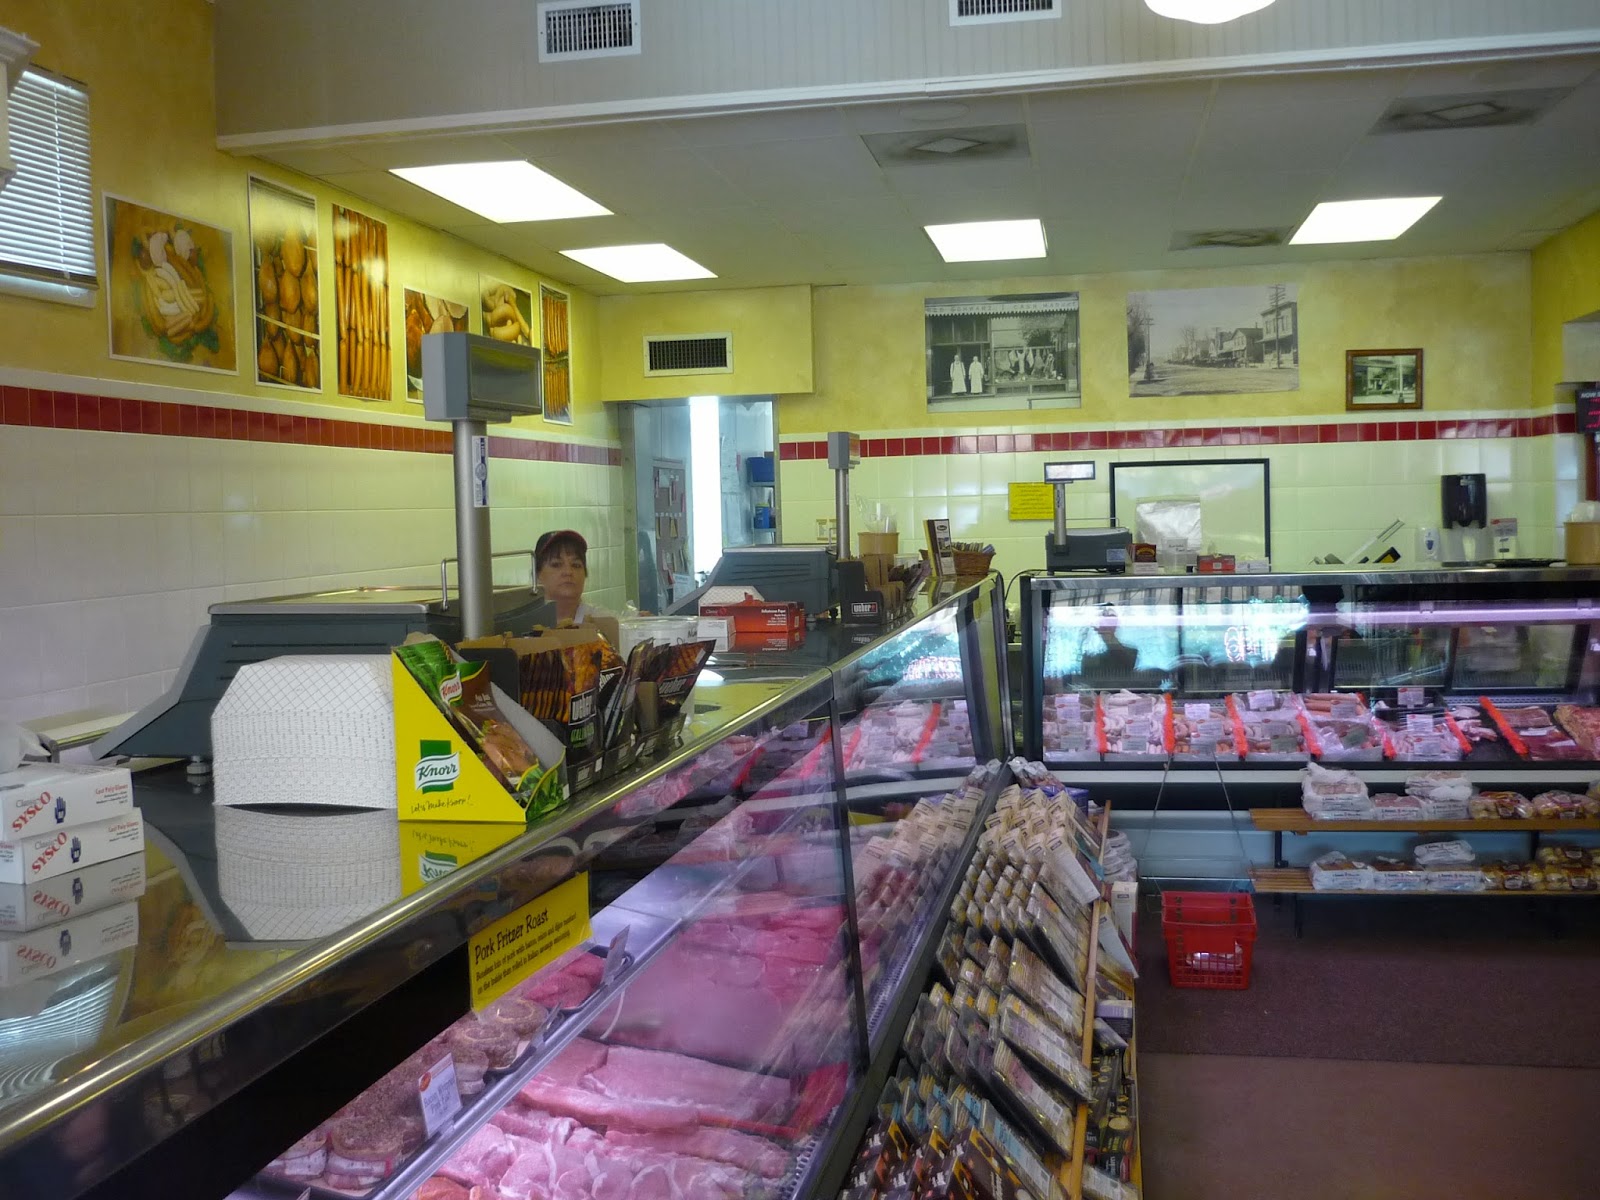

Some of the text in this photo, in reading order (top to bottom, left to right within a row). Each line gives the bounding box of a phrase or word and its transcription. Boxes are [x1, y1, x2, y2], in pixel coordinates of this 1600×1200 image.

[415, 763, 459, 781] Knorr
[12, 791, 51, 832] SYSCO
[31, 831, 67, 874] SYSCO
[474, 906, 549, 966] Pork Fritzer Roast
